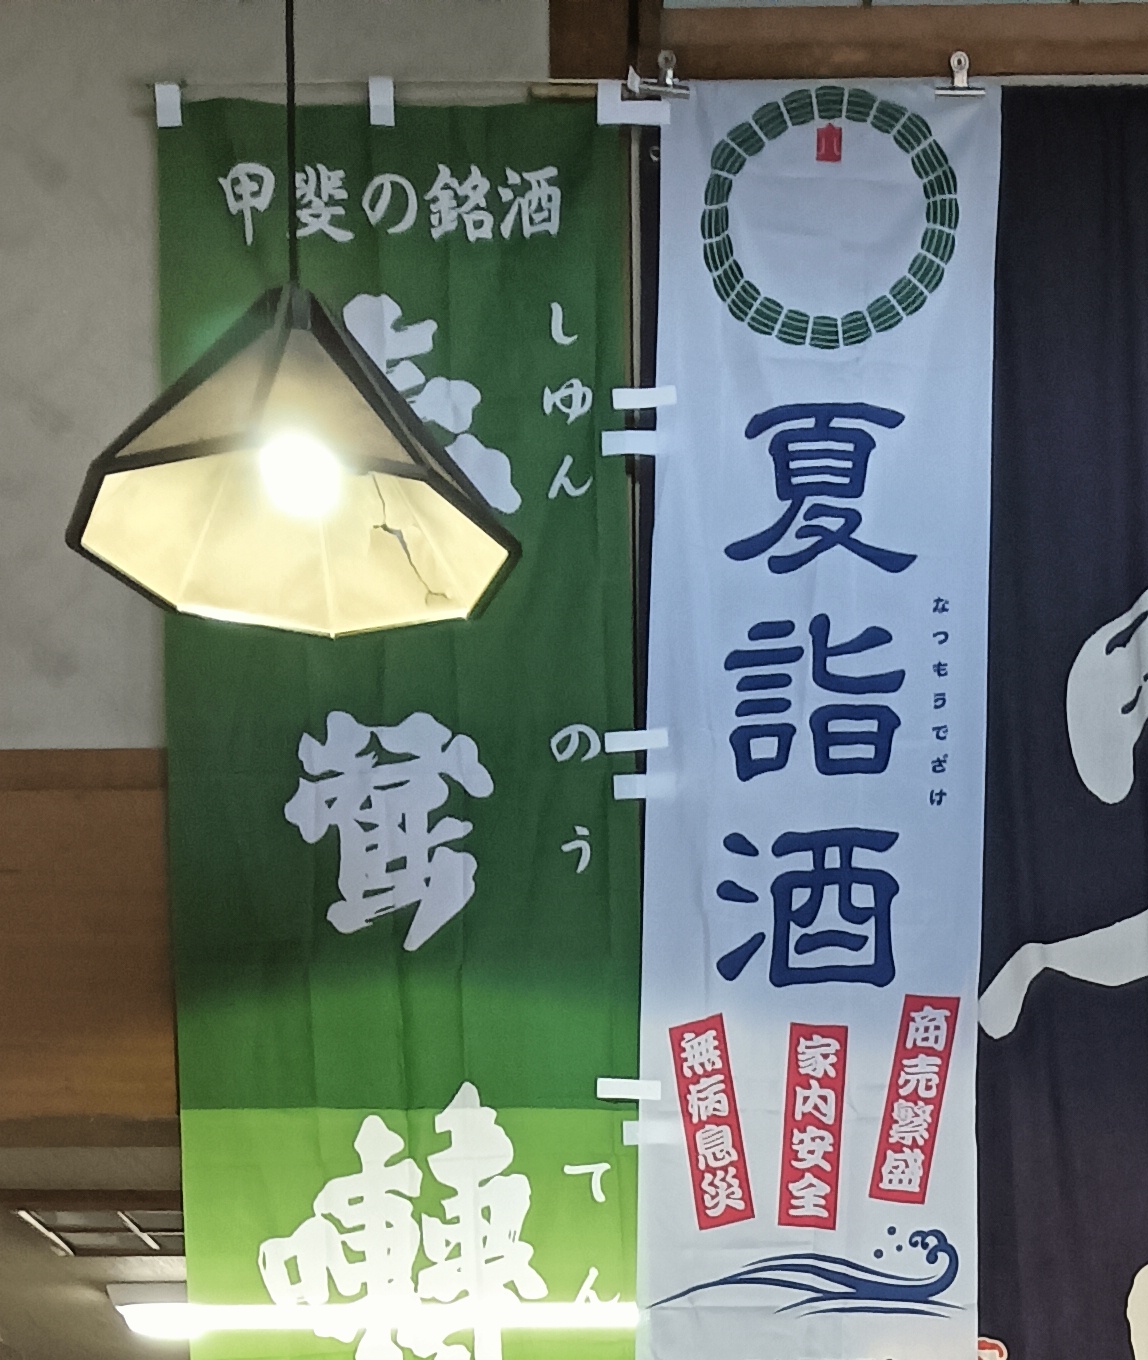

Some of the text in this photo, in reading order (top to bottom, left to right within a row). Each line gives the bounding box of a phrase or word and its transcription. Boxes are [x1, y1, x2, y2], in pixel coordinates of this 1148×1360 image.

[220, 162, 563, 247] 甲斐の銘酒
[715, 402, 918, 988] 夏詣酒
[929, 597, 951, 807] なつもうでざけ
[679, 1030, 746, 1213] 無病息災
[788, 1034, 839, 1221] 家内安全
[879, 1005, 954, 1195] 商売繁盛
